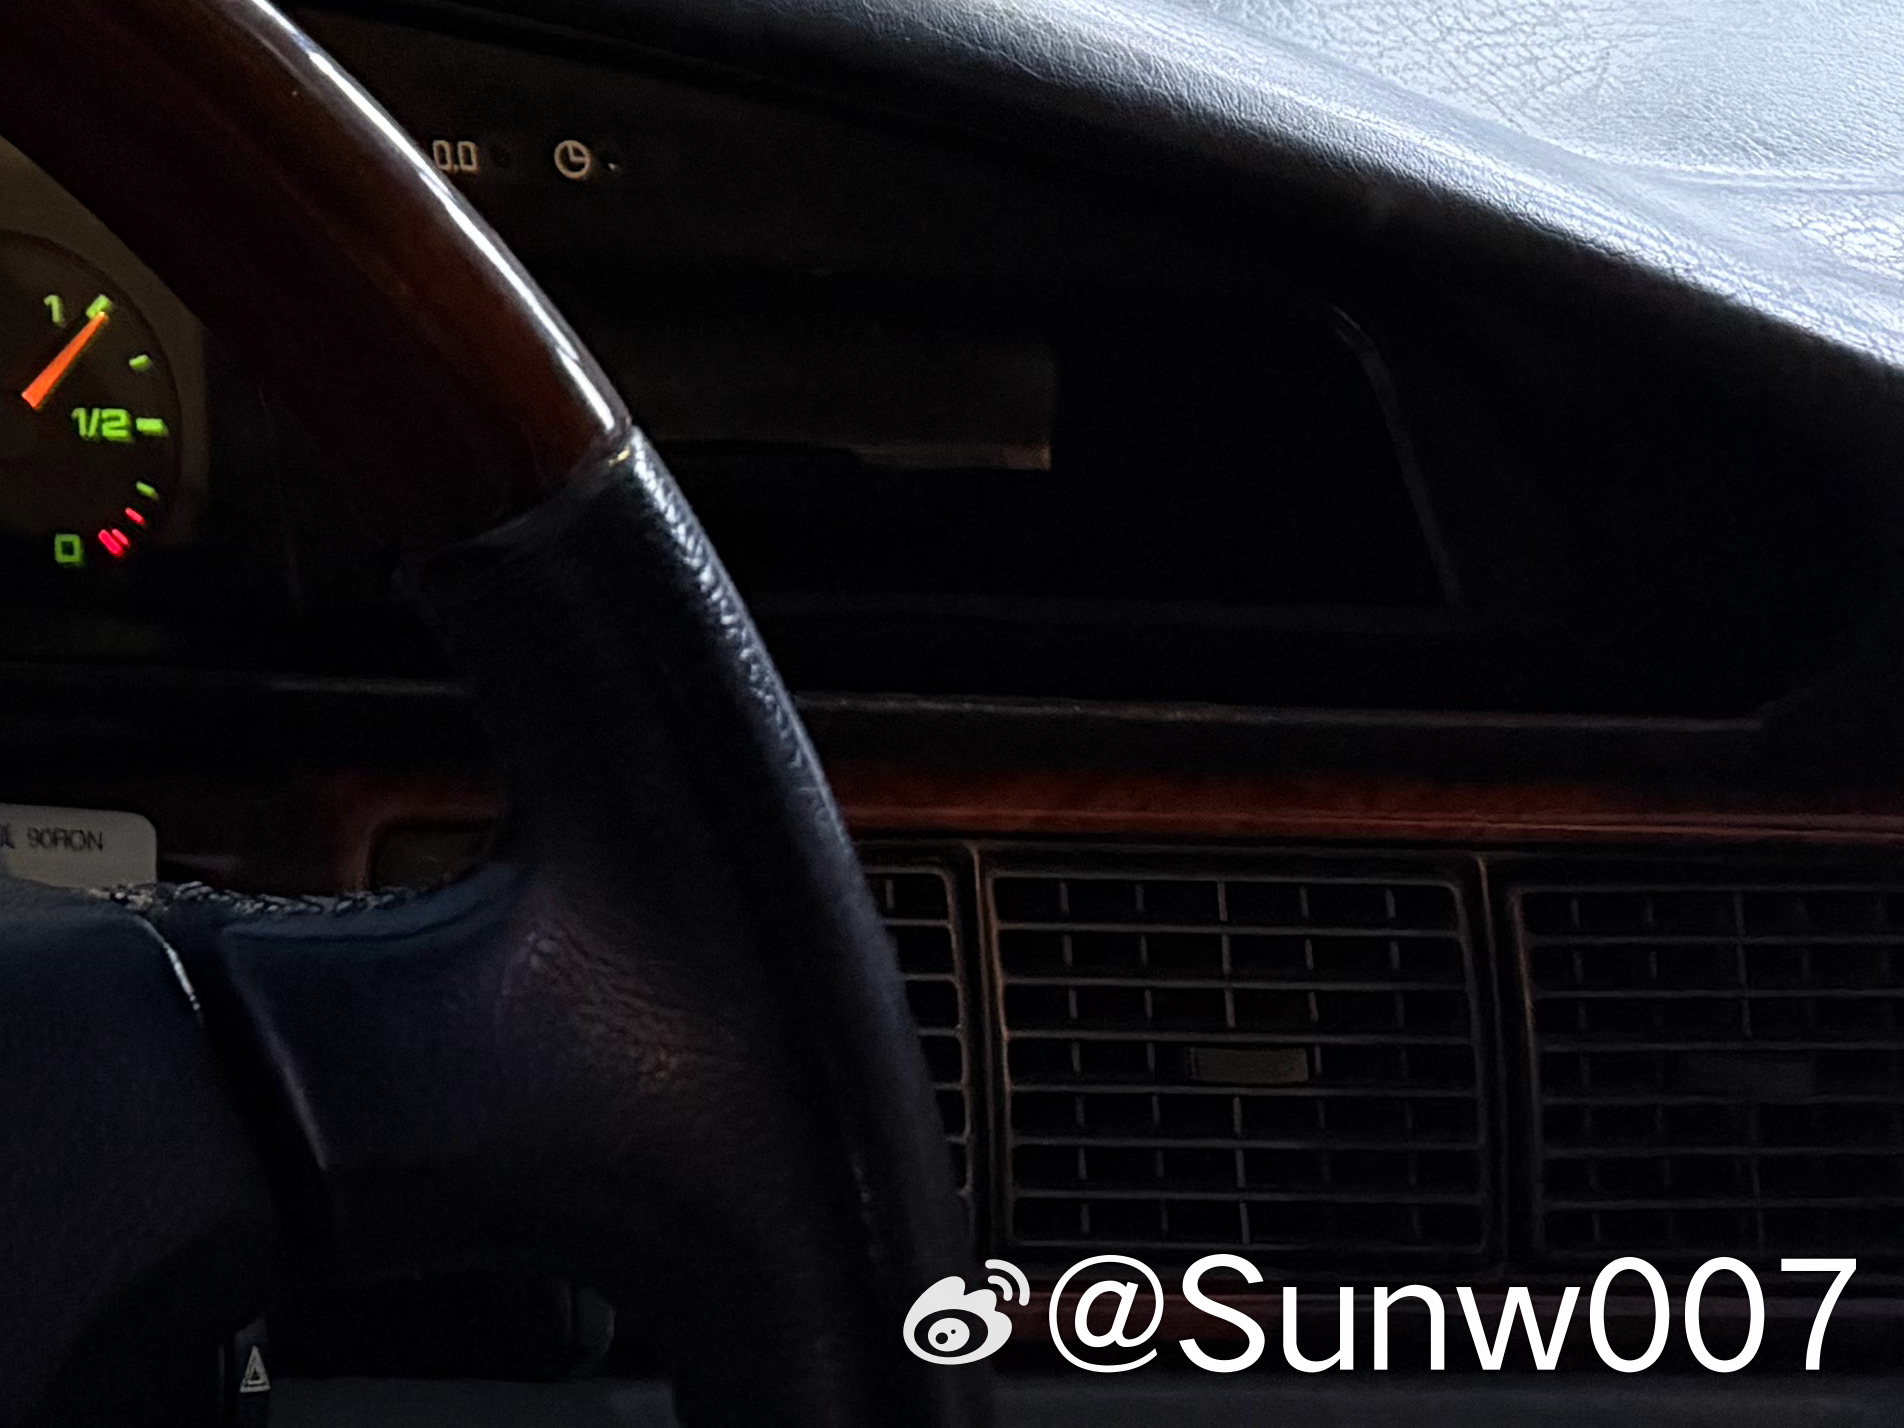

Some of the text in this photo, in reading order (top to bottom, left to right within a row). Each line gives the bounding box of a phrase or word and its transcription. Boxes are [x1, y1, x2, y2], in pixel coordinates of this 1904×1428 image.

[43, 293, 63, 324] 1
[72, 406, 131, 442] 1/2
[54, 532, 84, 565] 0
